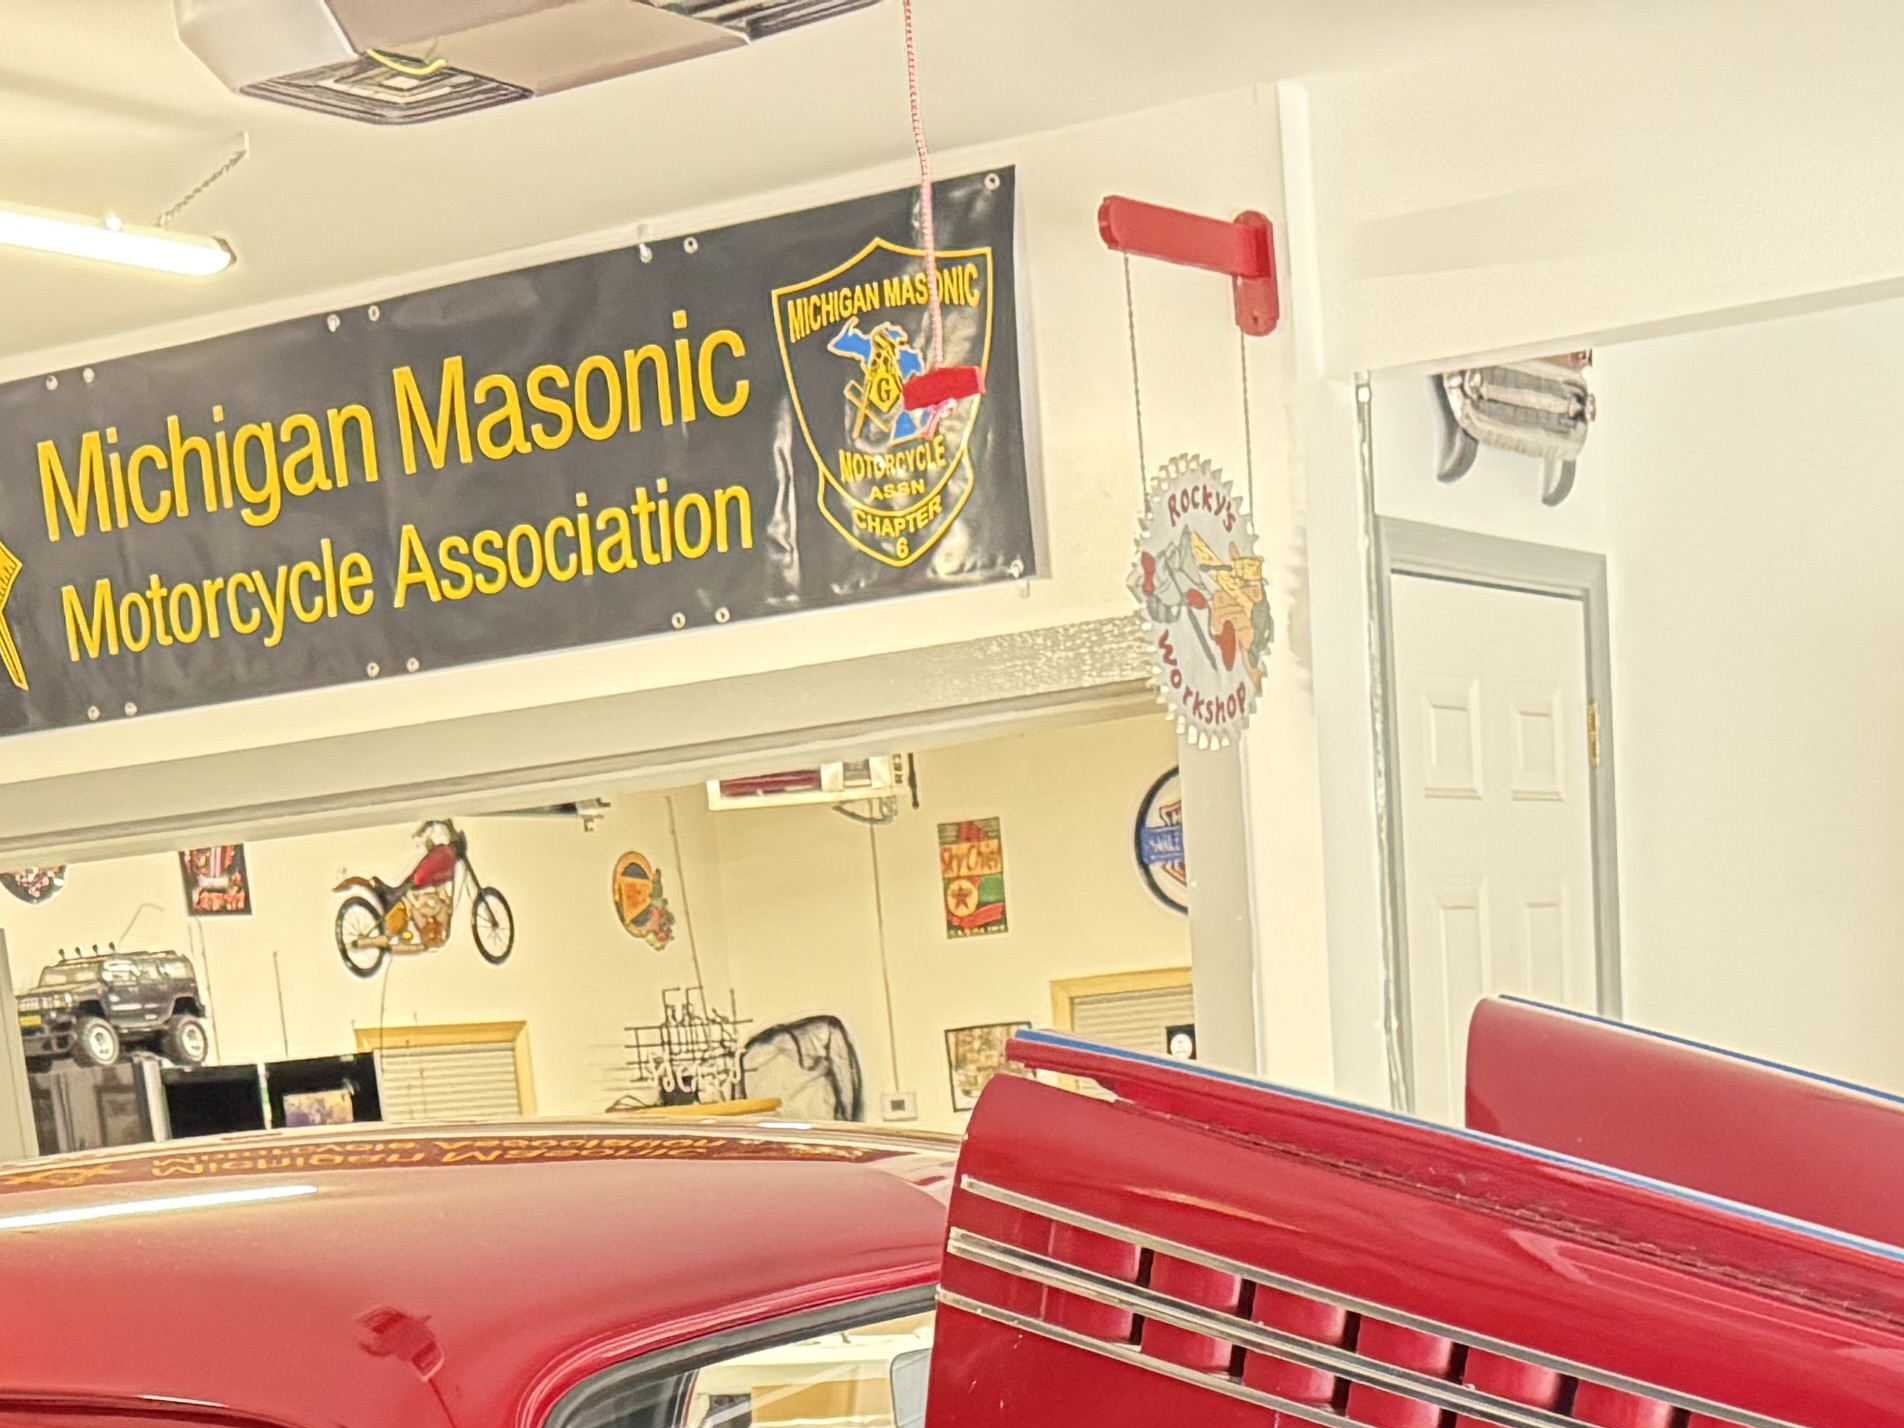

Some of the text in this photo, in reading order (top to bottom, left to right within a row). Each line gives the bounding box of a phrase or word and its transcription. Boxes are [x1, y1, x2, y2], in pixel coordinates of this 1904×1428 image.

[787, 282, 880, 343] MICHIGAN
[37, 310, 749, 542] Michigan Masonic
[839, 435, 946, 483] MOTORCYCLE
[869, 479, 925, 500] ASSN
[852, 495, 942, 537] CHAPTER
[61, 477, 753, 662] Motorcycle Association
[897, 537, 909, 559] 6
